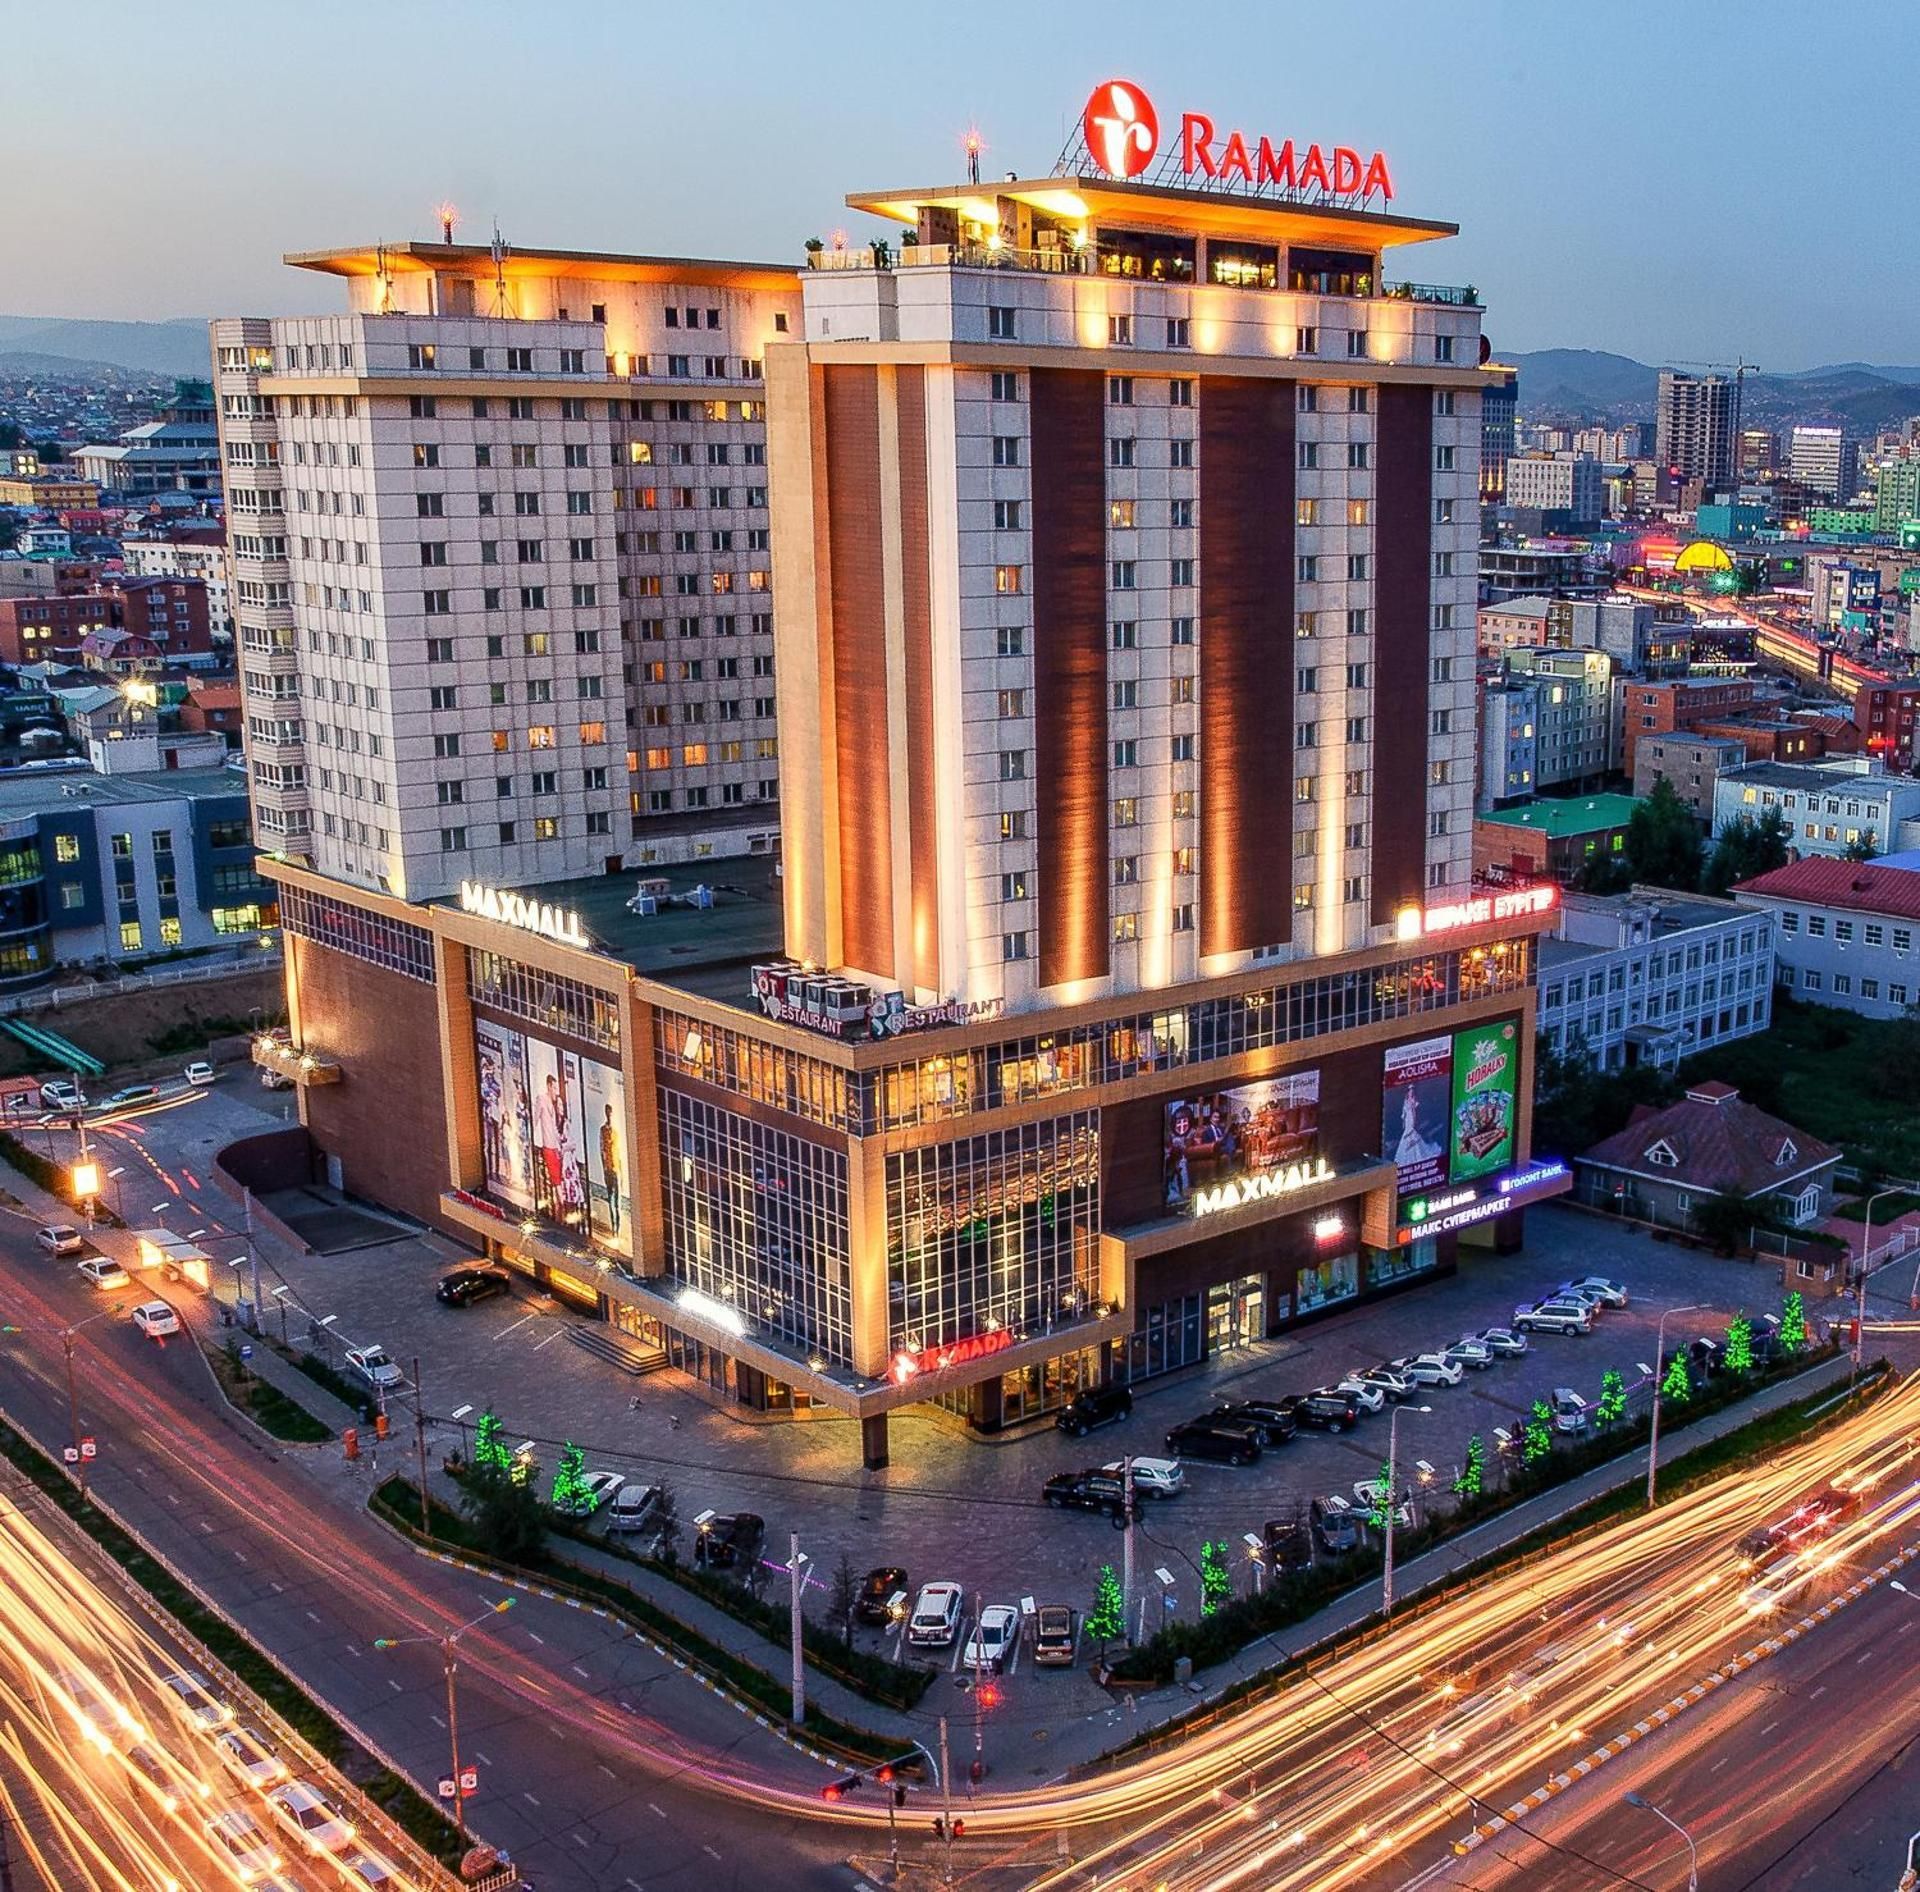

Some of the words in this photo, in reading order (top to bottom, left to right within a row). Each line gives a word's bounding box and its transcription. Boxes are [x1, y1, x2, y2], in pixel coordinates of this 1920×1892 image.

[1182, 112, 1395, 200] RAMADA
[461, 879, 589, 948] MAXMALL
[890, 998, 1003, 1034] RESTAURANT
[1195, 1158, 1336, 1217] MAXMALL
[1411, 1218, 1442, 1239] МАКС
[1443, 1196, 1511, 1229] СУПЕРМАРКЕТ
